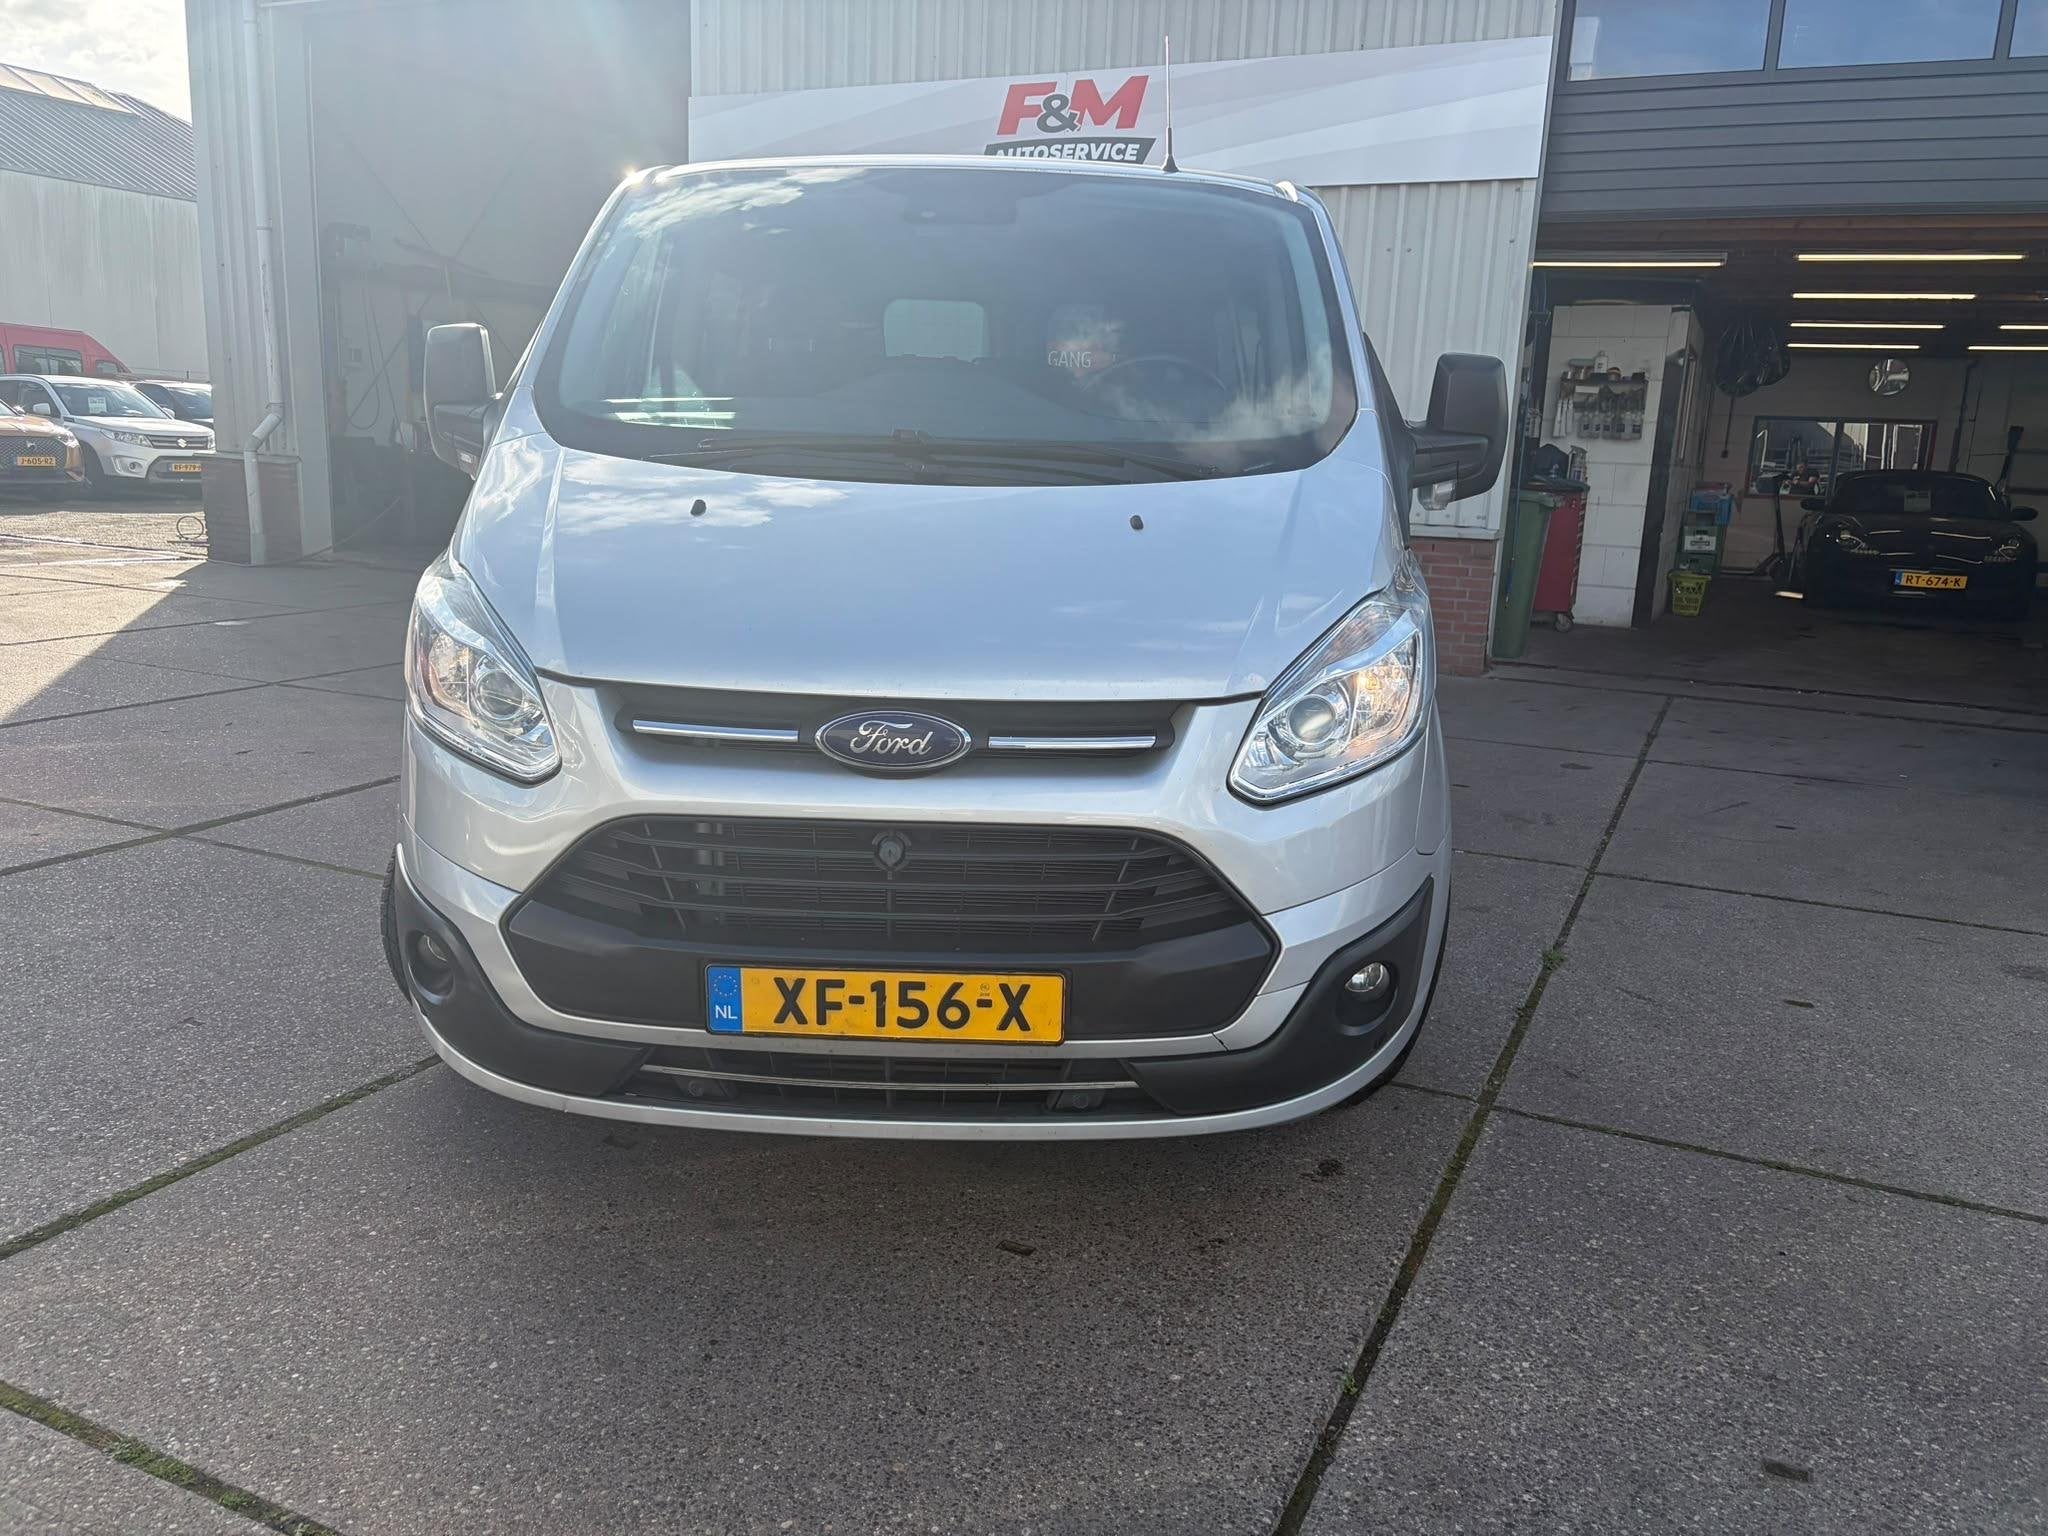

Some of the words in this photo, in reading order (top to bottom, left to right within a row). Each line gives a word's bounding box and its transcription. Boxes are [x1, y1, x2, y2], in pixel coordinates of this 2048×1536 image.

[997, 75, 1149, 135] F&M
[1905, 574, 1961, 588] RT-674-K
[850, 720, 934, 756] Ford
[715, 1004, 738, 1020] NL
[773, 976, 1031, 1032] XF-156-X
